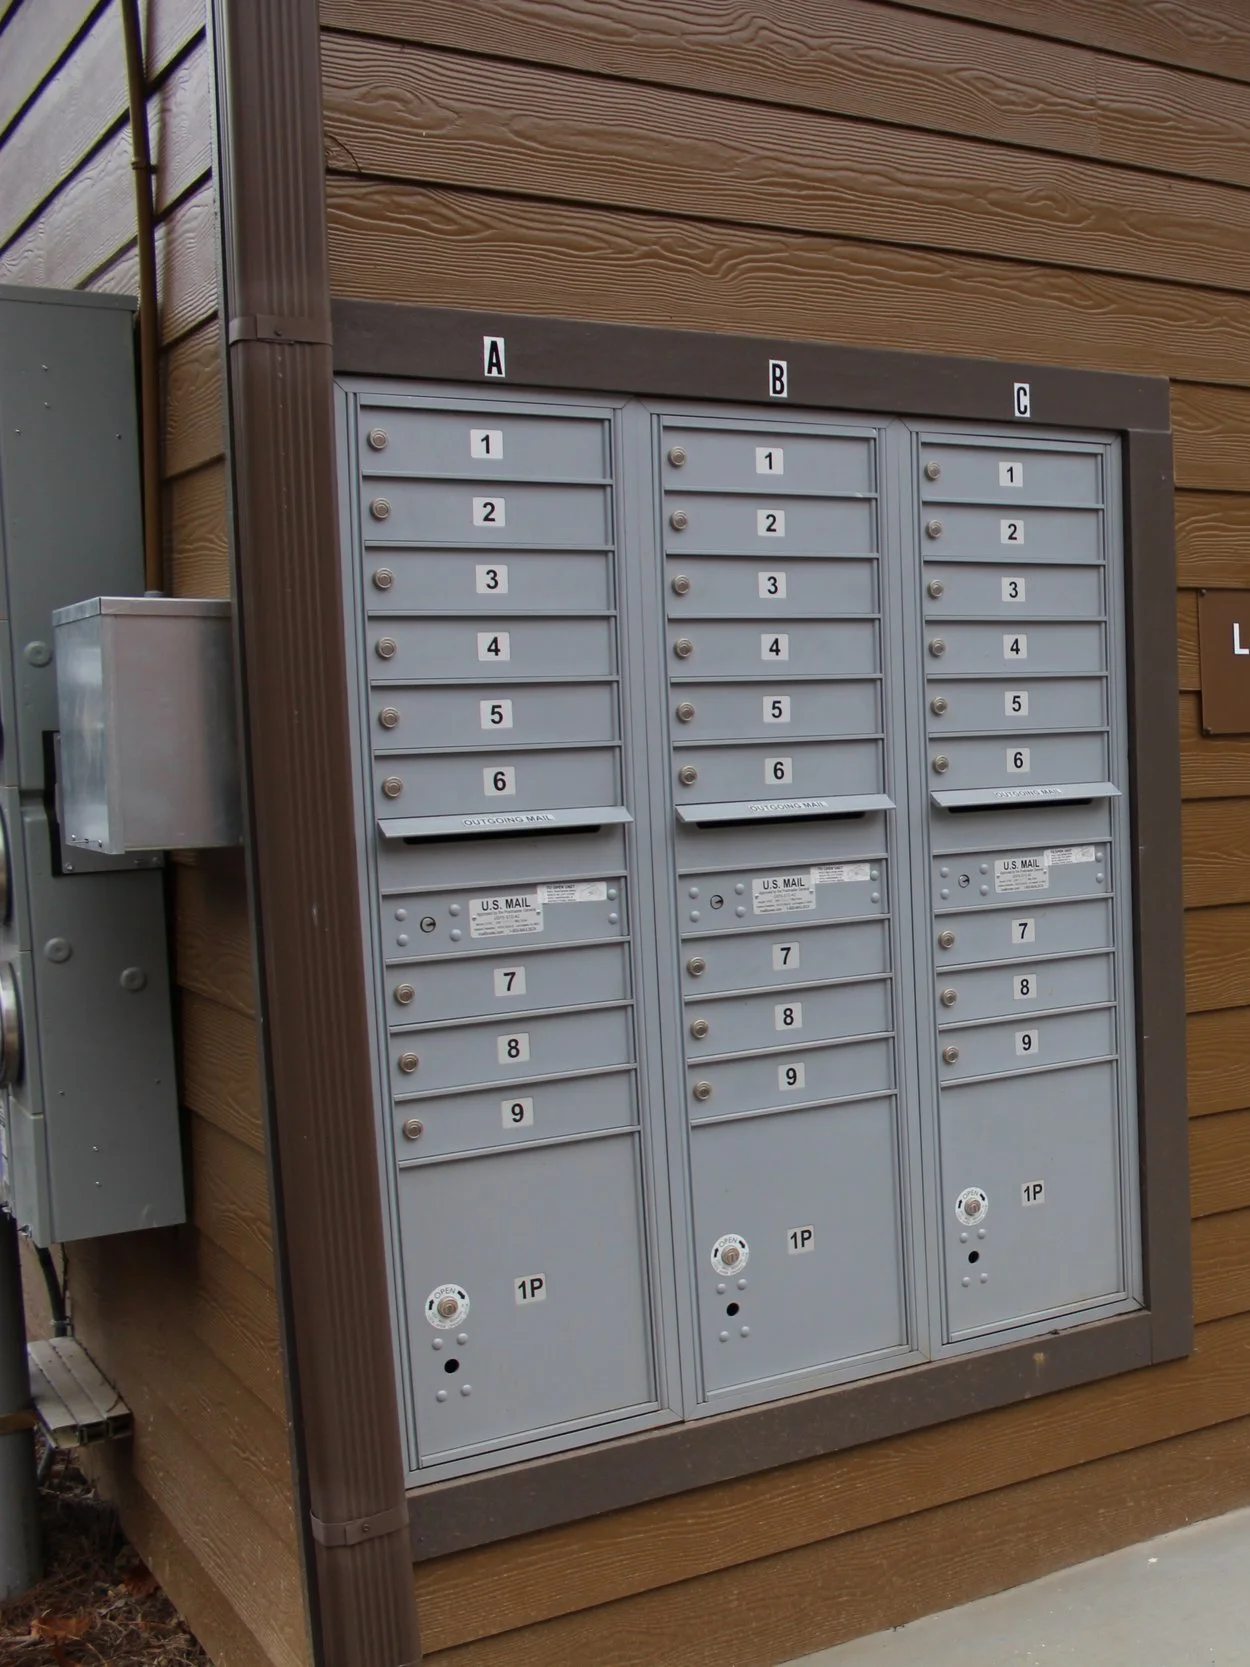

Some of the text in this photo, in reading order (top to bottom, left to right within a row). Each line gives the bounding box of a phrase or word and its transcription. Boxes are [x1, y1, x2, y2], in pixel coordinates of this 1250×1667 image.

[486, 340, 503, 375] A
[771, 363, 785, 395] B
[1016, 386, 1028, 415] C
[480, 434, 490, 454] 1
[764, 452, 773, 470] 1
[1006, 466, 1014, 483] 1
[482, 501, 496, 522] 2
[765, 514, 777, 533] 2
[1007, 523, 1018, 541] 2
[486, 569, 499, 590] 3
[767, 576, 778, 595] 3
[1009, 581, 1019, 599] 3
[487, 636, 501, 657] 4
[768, 637, 781, 656] 4
[1010, 638, 1021, 655] 4
[771, 700, 783, 719] 5
[1012, 695, 1022, 712] 5
[490, 704, 504, 725] 5
[1013, 751, 1024, 769] 6
[773, 761, 785, 780] 6
[493, 771, 507, 792] 6
[802, 800, 824, 809] MAIL
[463, 813, 554, 826] OUTGOING MAIL
[1003, 859, 1040, 871] U.S. MAIL
[762, 877, 805, 890] U.S. MAIL
[481, 897, 531, 911] U.S. MAIL
[1018, 922, 1028, 940] 7
[780, 946, 792, 965] 7
[503, 971, 516, 992] 7
[1020, 978, 1030, 996] 8
[783, 1007, 794, 1026] 8
[507, 1038, 520, 1059] 8
[1021, 1034, 1032, 1051] 9
[785, 1067, 797, 1086] 9
[511, 1103, 524, 1123] 9
[1023, 1183, 1043, 1202] 1P
[790, 1229, 812, 1249] 1P
[434, 1287, 456, 1299] OPEN
[518, 1277, 544, 1300] 1P
